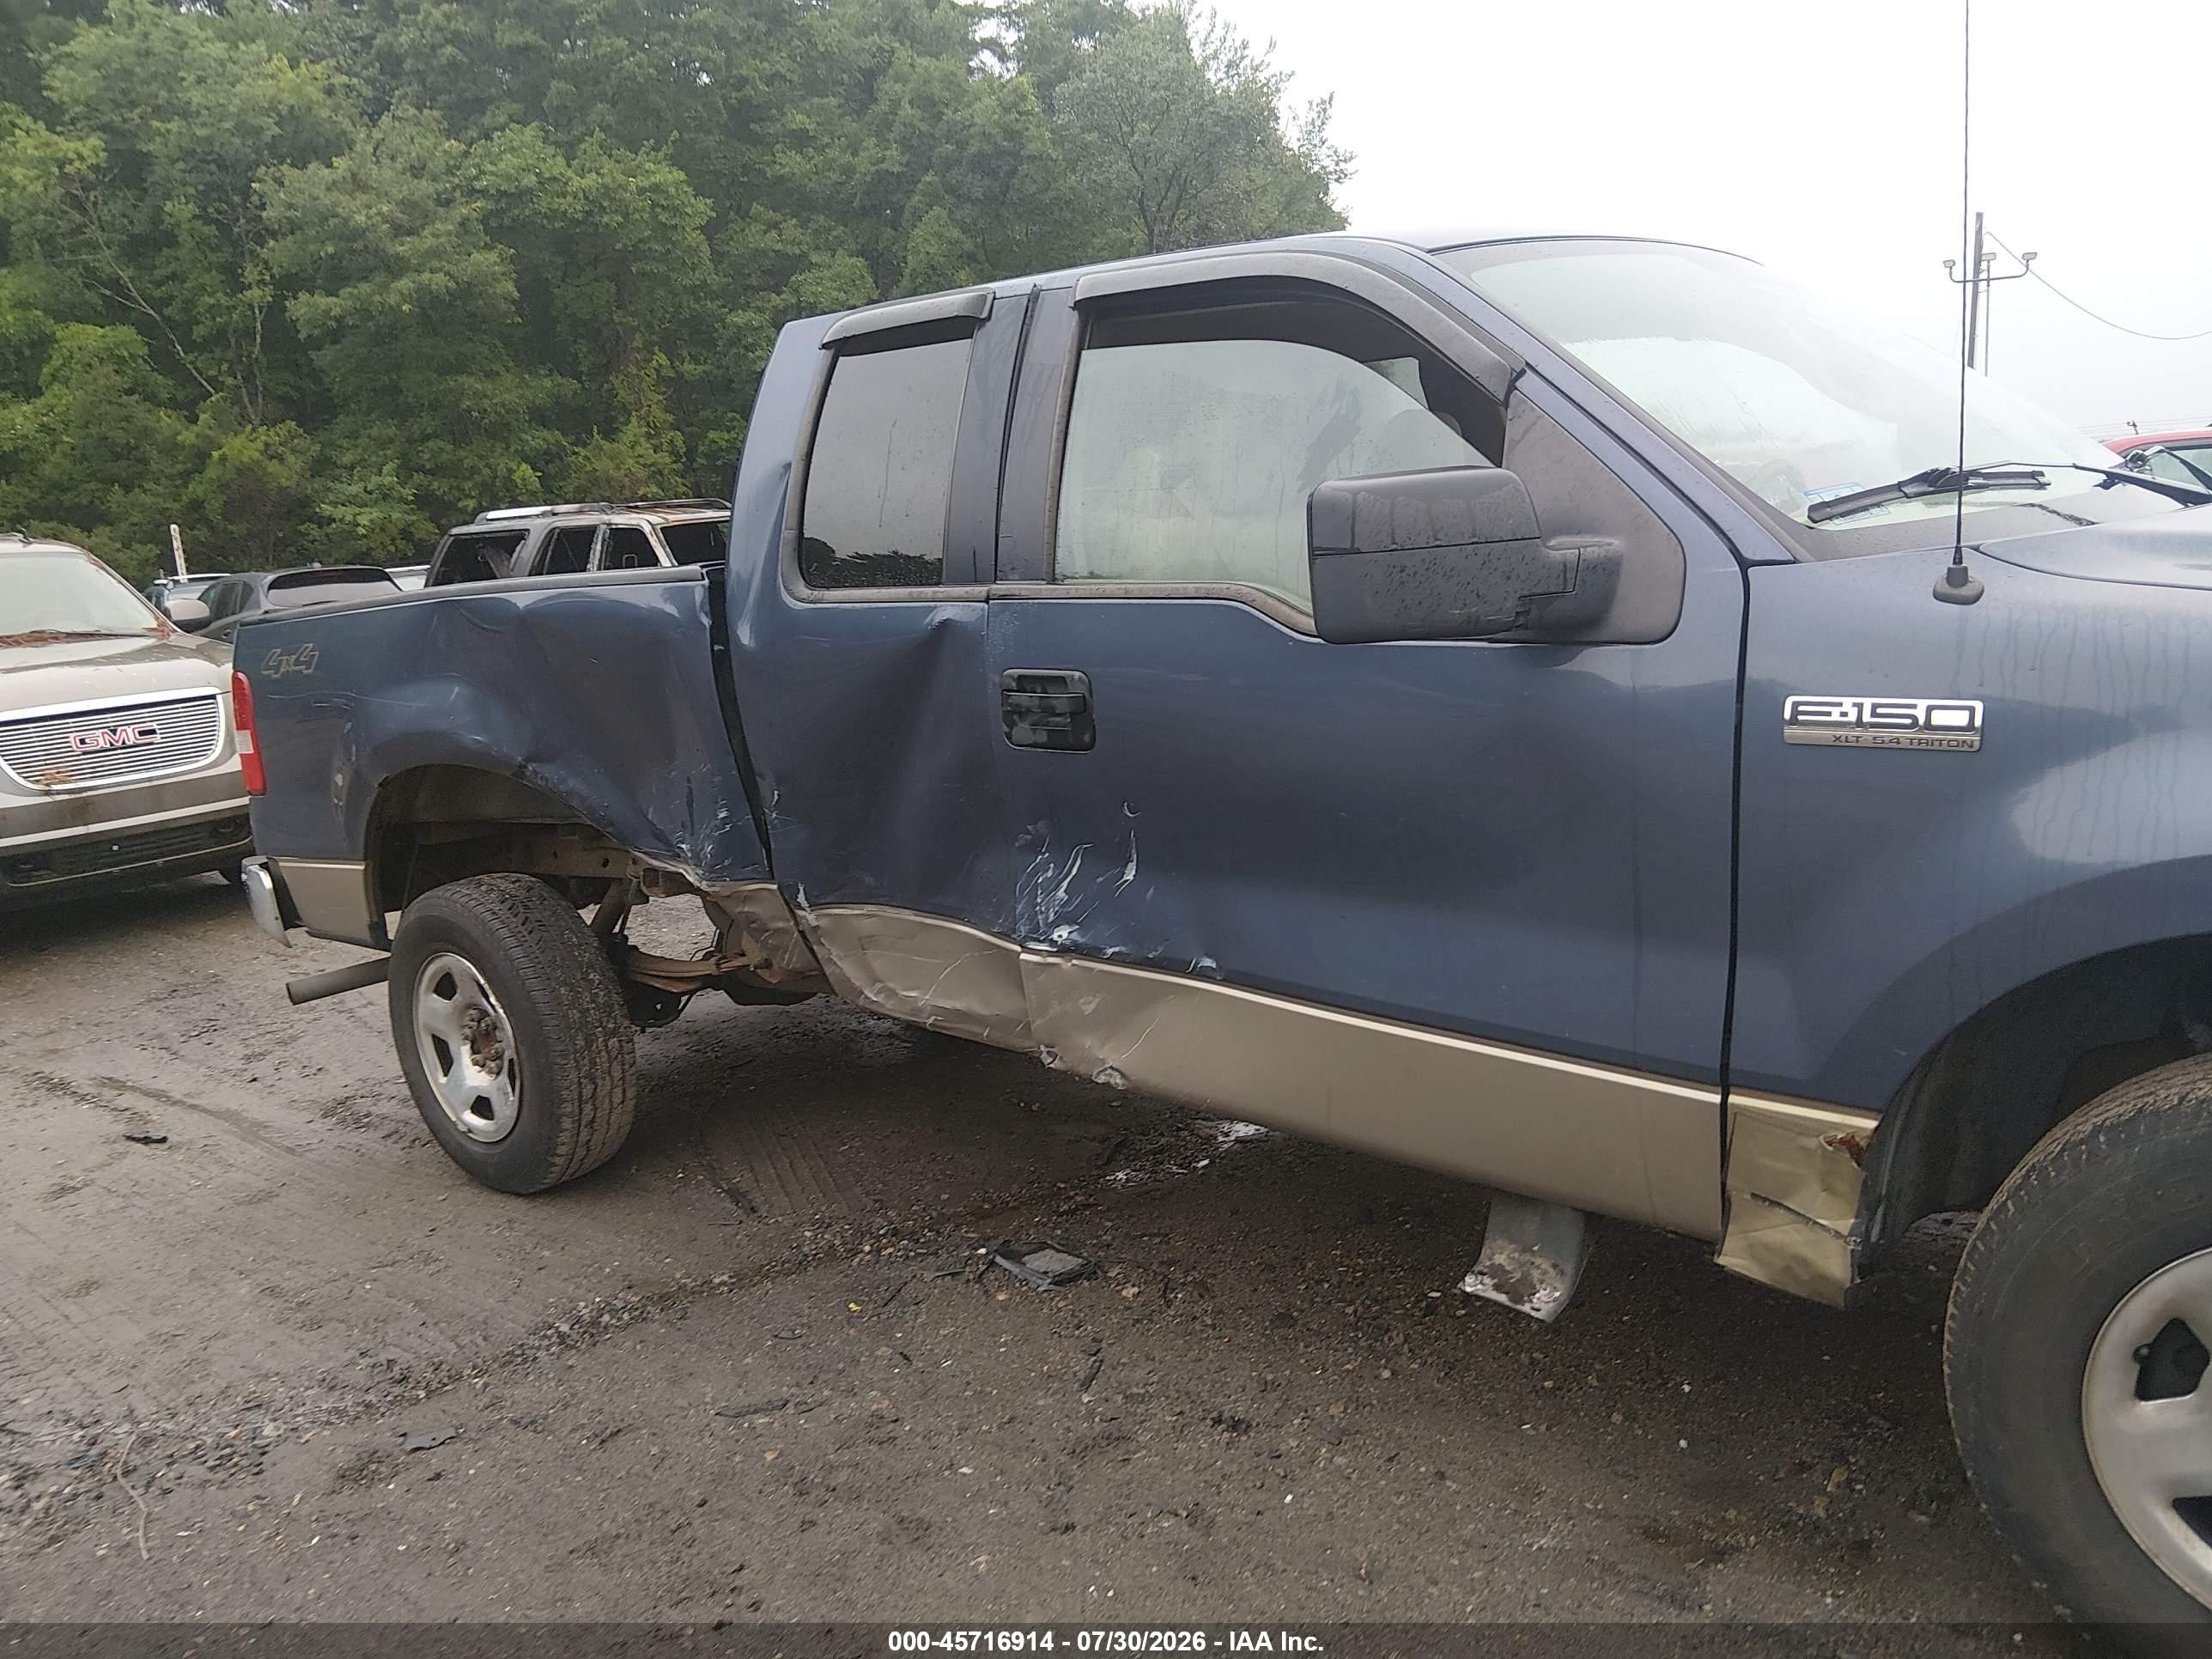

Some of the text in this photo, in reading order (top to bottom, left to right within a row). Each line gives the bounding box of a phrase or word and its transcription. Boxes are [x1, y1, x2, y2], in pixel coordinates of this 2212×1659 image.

[1787, 699, 1978, 733] F-150
[70, 724, 161, 751] GMC
[1832, 734, 1975, 750] XLT 5.4 TRITON
